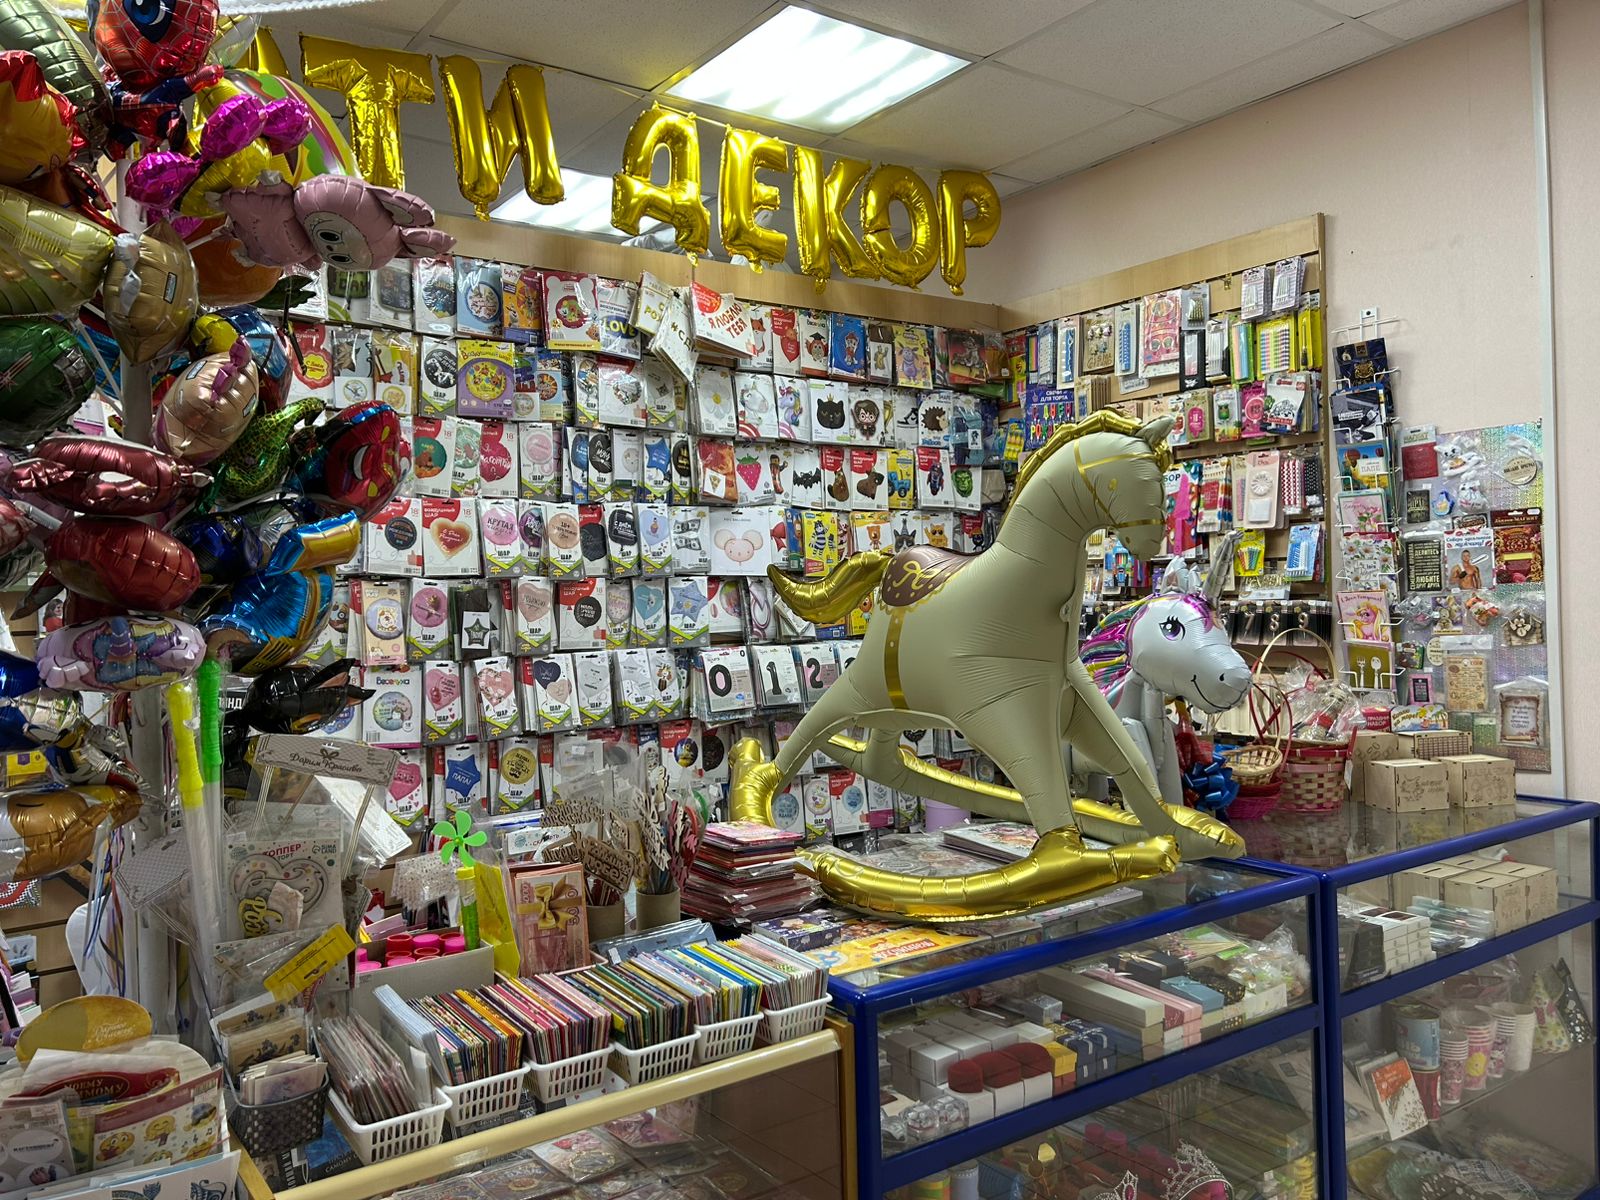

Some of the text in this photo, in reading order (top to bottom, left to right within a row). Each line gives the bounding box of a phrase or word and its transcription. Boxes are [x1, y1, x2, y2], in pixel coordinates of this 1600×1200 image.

[611, 100, 1002, 295] ДЕКОР
[708, 302, 743, 330] Я ЛЮБЛЮ
[726, 317, 748, 339] ТЕБЯ
[433, 390, 446, 399] ШАР
[1052, 394, 1069, 402] ТОРТА
[487, 517, 514, 531] КРУТАЯ
[1244, 611, 1255, 630] 7
[1269, 612, 1280, 632] 8
[1297, 611, 1309, 629] 9
[739, 649, 746, 657] 0
[708, 664, 733, 698] 0
[765, 660, 781, 696] 1
[806, 657, 823, 689] 2
[496, 709, 508, 717] ШАР
[289, 752, 363, 774] Дарим Красиво
[510, 789, 523, 797] ШАР
[398, 804, 413, 812] ШАР
